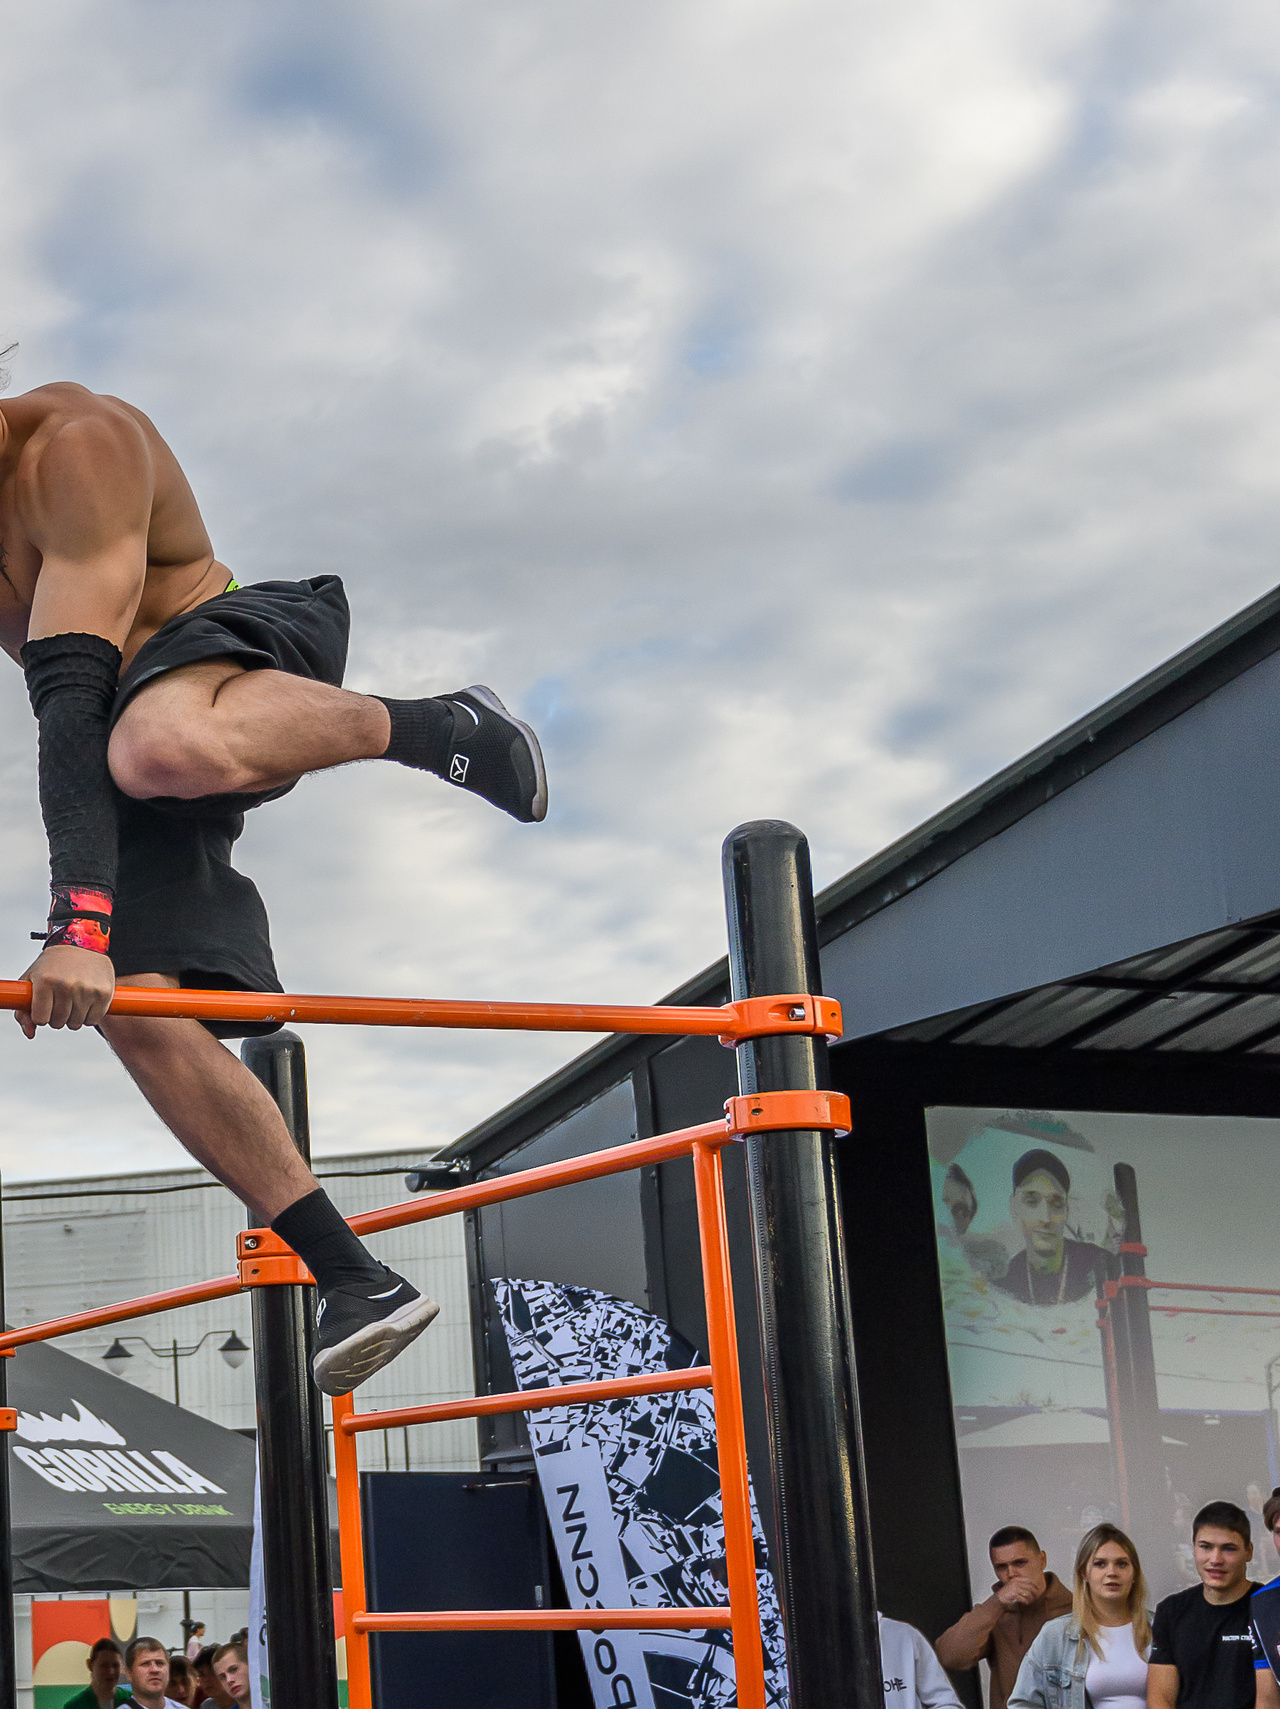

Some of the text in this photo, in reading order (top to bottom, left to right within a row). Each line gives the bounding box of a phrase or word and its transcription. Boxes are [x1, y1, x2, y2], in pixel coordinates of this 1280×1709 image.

[12, 1446, 228, 1494] GORILLA
[102, 1503, 234, 1516] ENERGY DRINK
